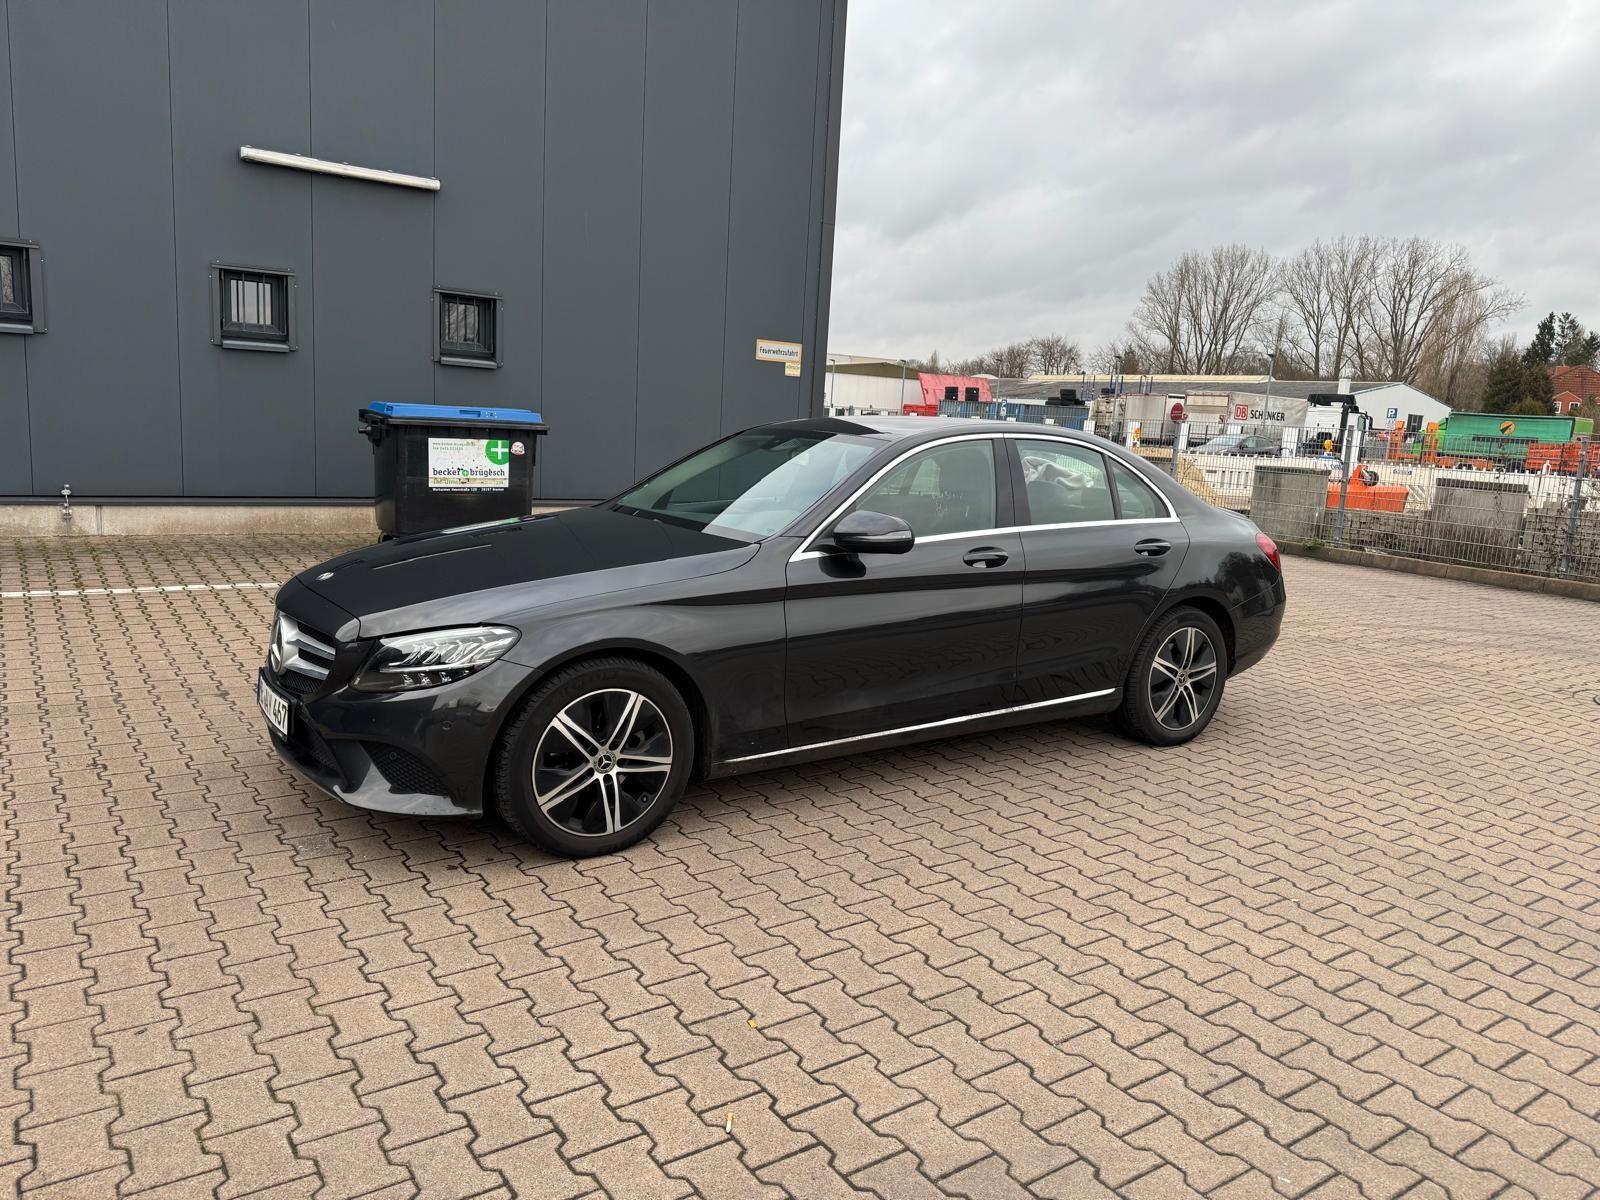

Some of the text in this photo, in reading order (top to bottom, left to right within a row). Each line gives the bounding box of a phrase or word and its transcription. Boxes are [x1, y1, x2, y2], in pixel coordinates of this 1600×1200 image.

[1235, 405, 1247, 419] DB
[1250, 409, 1285, 422] SCHNKER
[432, 467, 505, 478] becker brügesch
